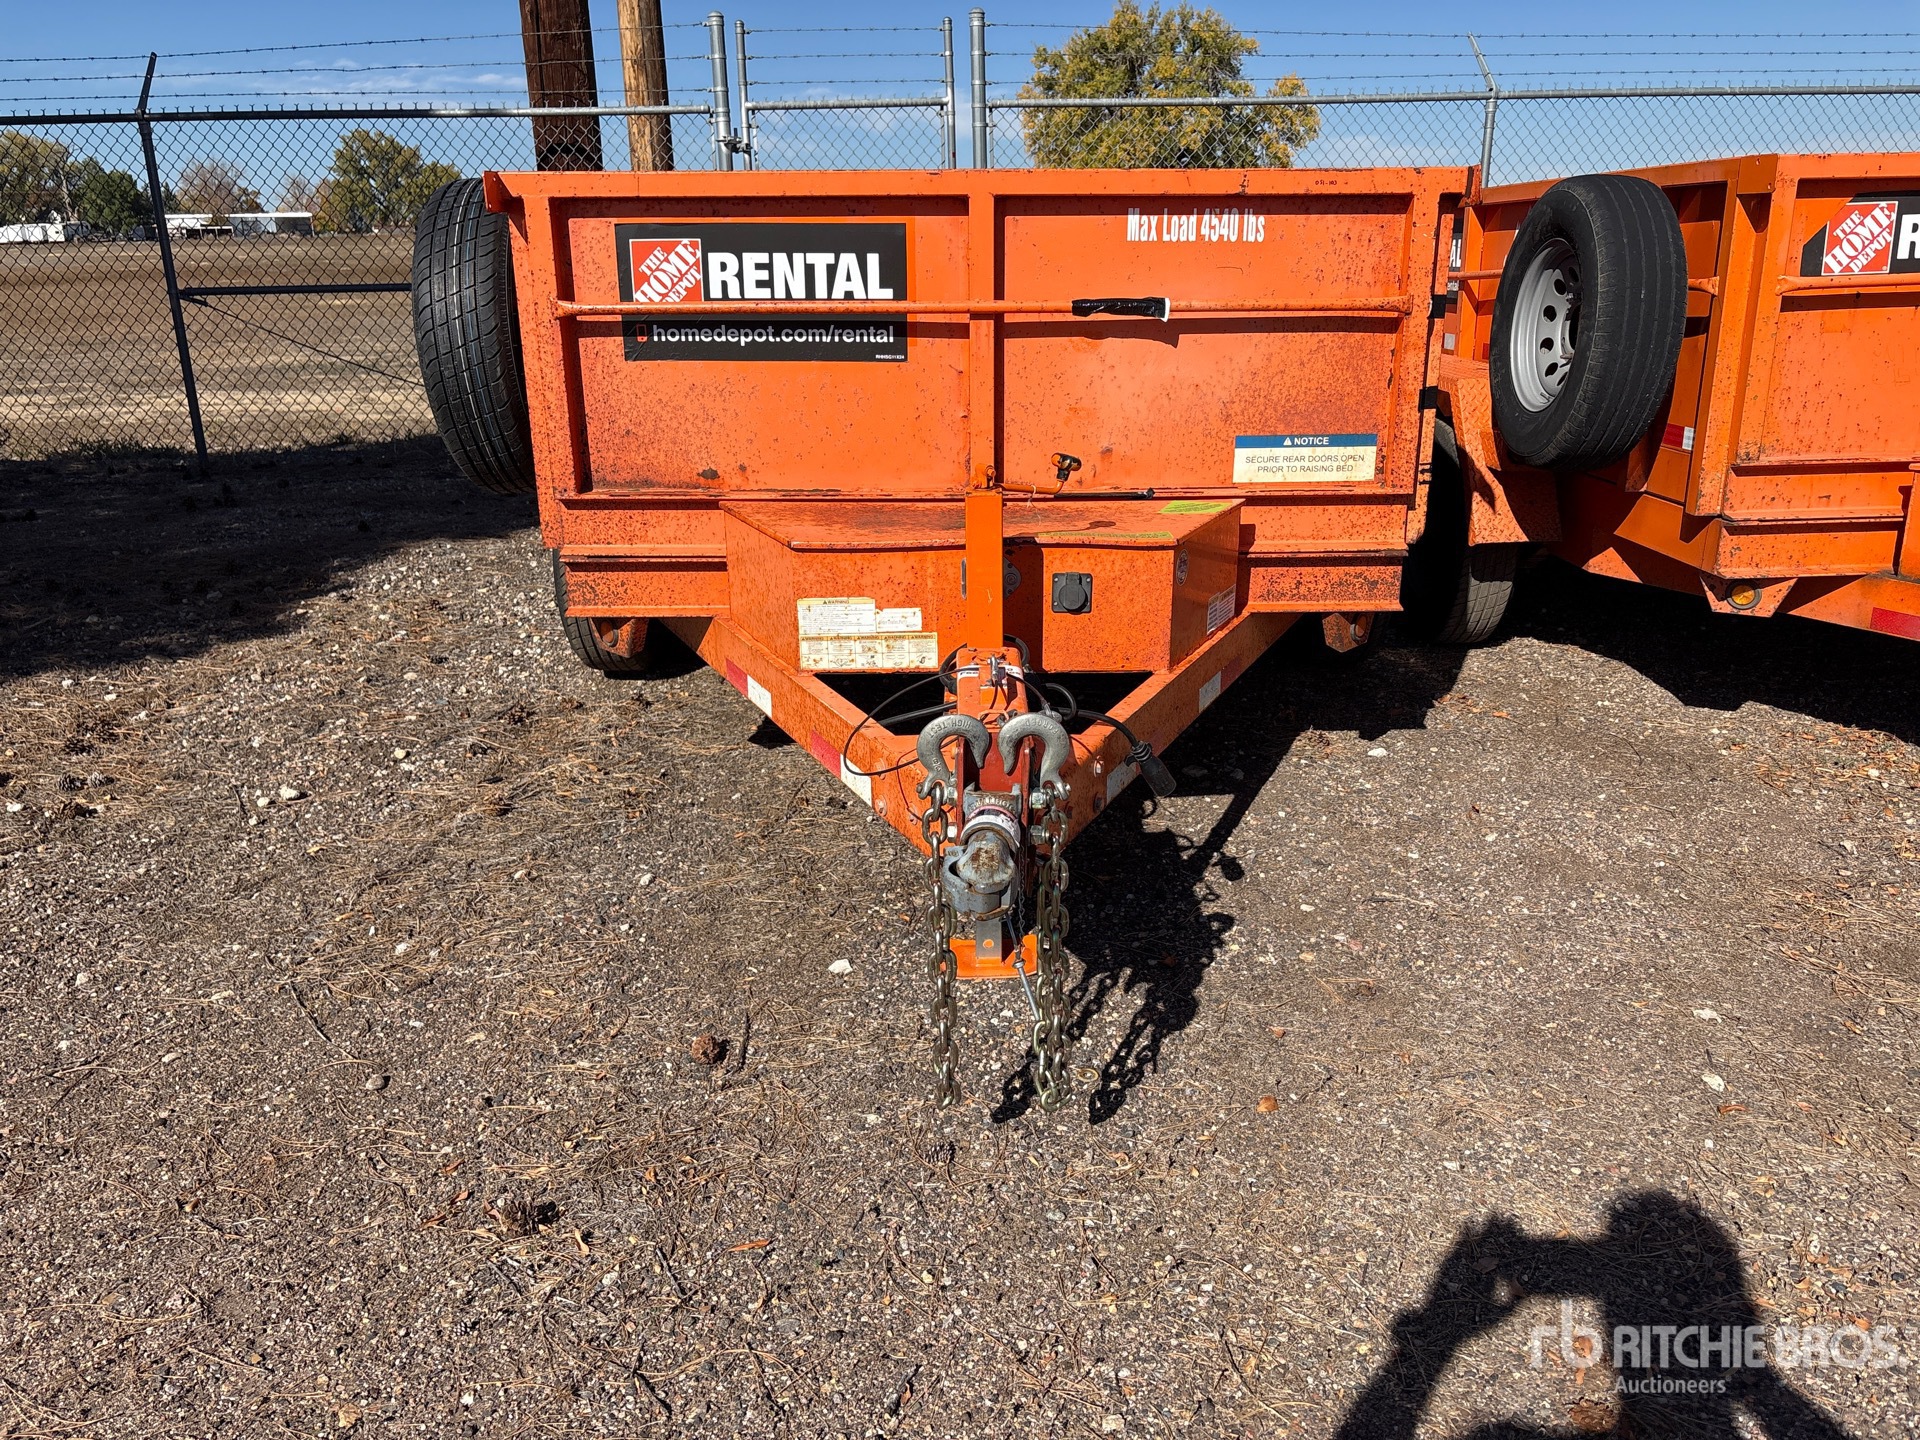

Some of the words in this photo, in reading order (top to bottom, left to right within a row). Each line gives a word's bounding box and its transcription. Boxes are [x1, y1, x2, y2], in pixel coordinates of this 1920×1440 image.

[1126, 208, 1158, 242] Max
[1162, 208, 1198, 242] Load
[1200, 208, 1240, 242] 4540
[1242, 208, 1266, 243] lbs
[1824, 202, 1896, 274] HOME
[1832, 210, 1864, 240] THE
[638, 246, 668, 277] THE
[1848, 228, 1893, 274] DEPOT
[634, 240, 701, 303] HOME
[707, 252, 894, 300] RENTAL
[652, 324, 895, 347] homedepot.com/rental
[1293, 436, 1330, 446] NOTICE
[1245, 455, 1281, 464] SECURE
[1282, 455, 1306, 463] REAR
[1307, 454, 1339, 463] DOORS
[1340, 454, 1366, 462] OPEN
[1257, 465, 1284, 474] PRIOR
[1286, 465, 1298, 473] TO
[1300, 464, 1334, 473] RAISING
[1336, 464, 1354, 473] BED
[926, 722, 948, 738] TEST
[951, 717, 972, 729] HIGH
